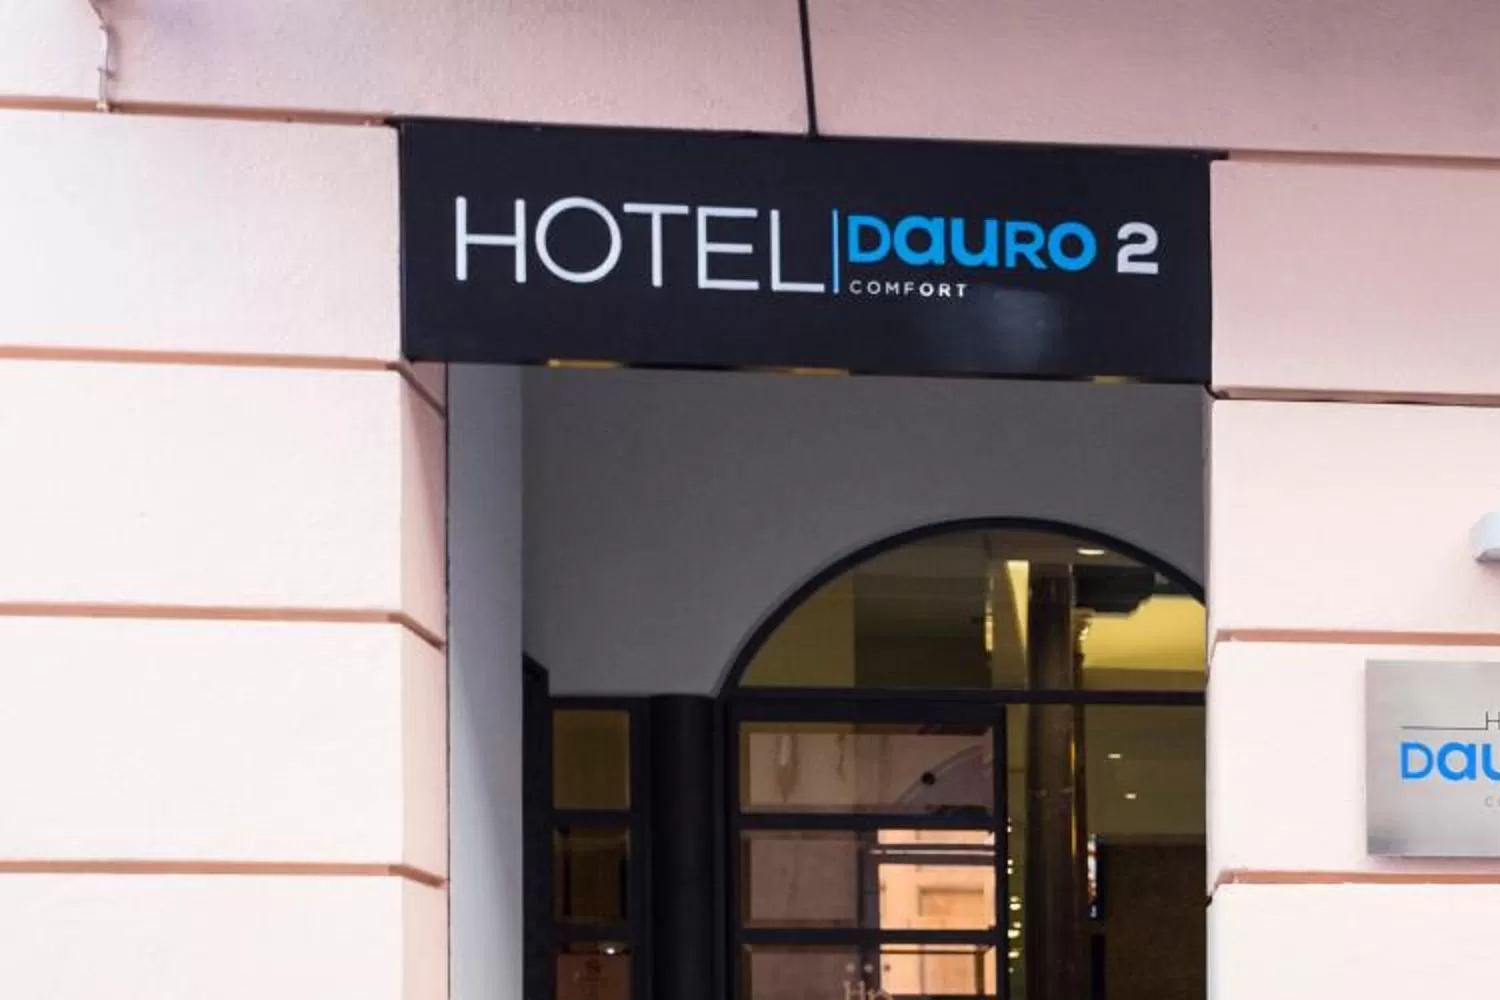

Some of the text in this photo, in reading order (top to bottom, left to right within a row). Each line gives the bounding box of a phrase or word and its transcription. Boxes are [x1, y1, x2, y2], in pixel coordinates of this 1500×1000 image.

[454, 195, 825, 293] HOTEL
[1116, 221, 1160, 275] 2
[848, 279, 968, 299] COMFORT
